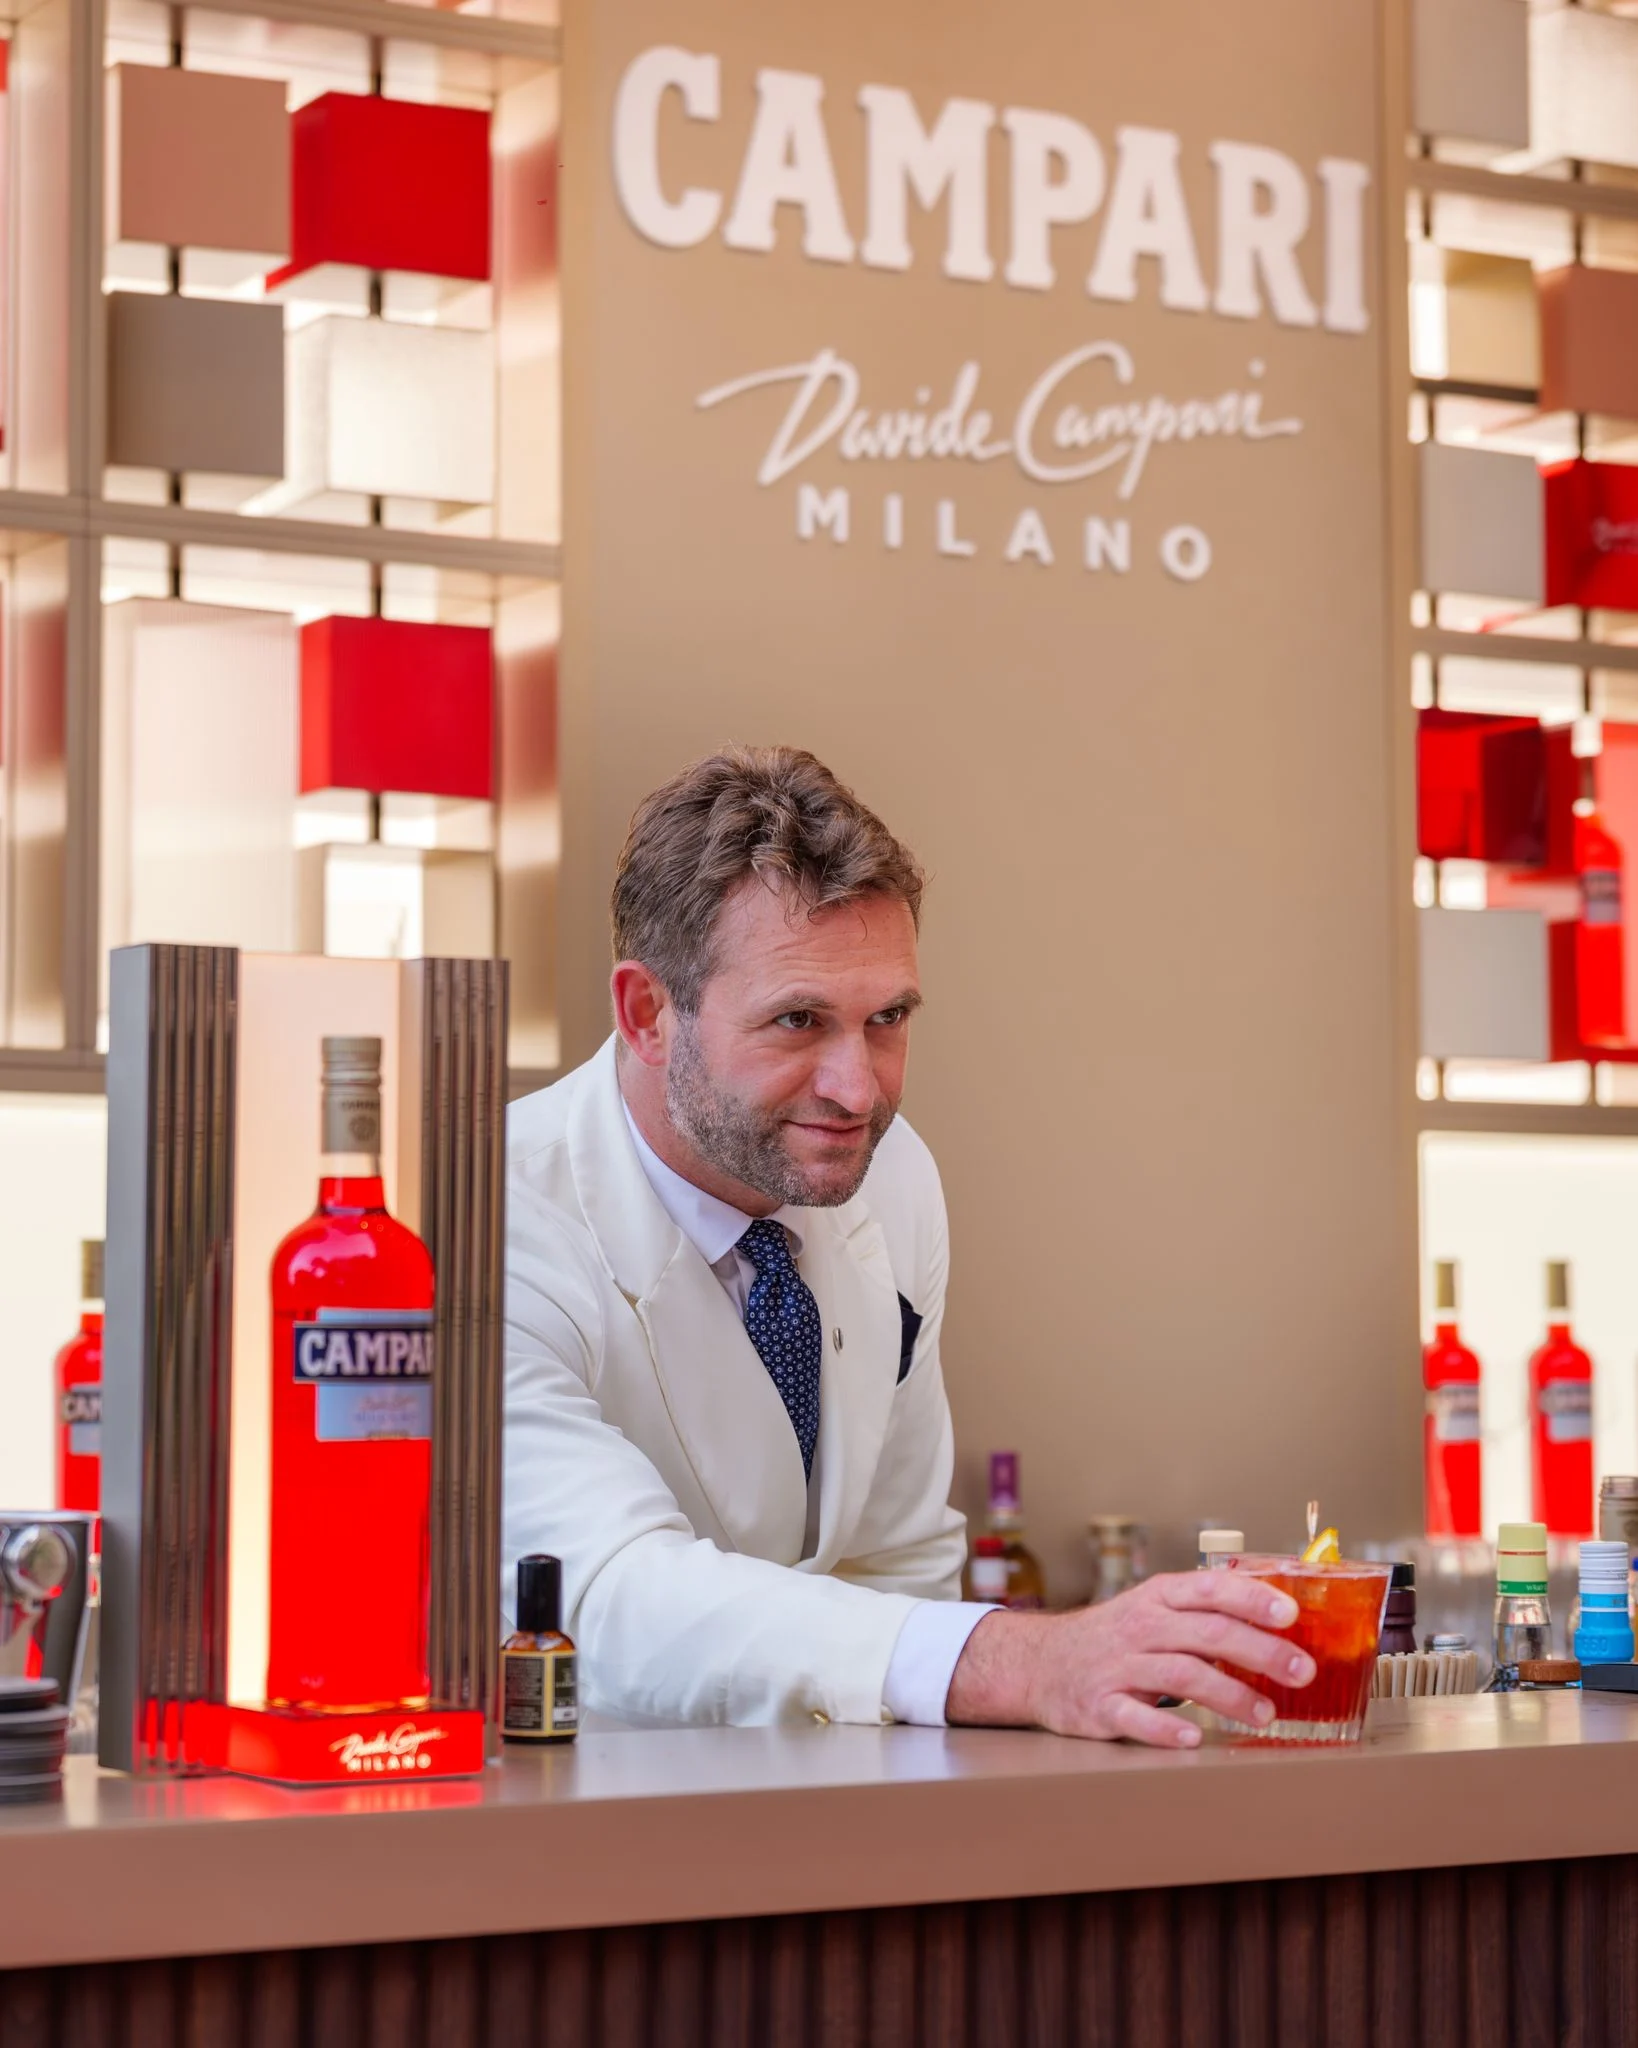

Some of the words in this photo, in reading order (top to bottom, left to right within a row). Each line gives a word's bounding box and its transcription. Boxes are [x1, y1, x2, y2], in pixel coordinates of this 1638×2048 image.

[614, 45, 1370, 333] CAMPARI
[696, 348, 1013, 486] Davide
[1012, 341, 1303, 501] Campari
[797, 484, 1212, 582] MILANO
